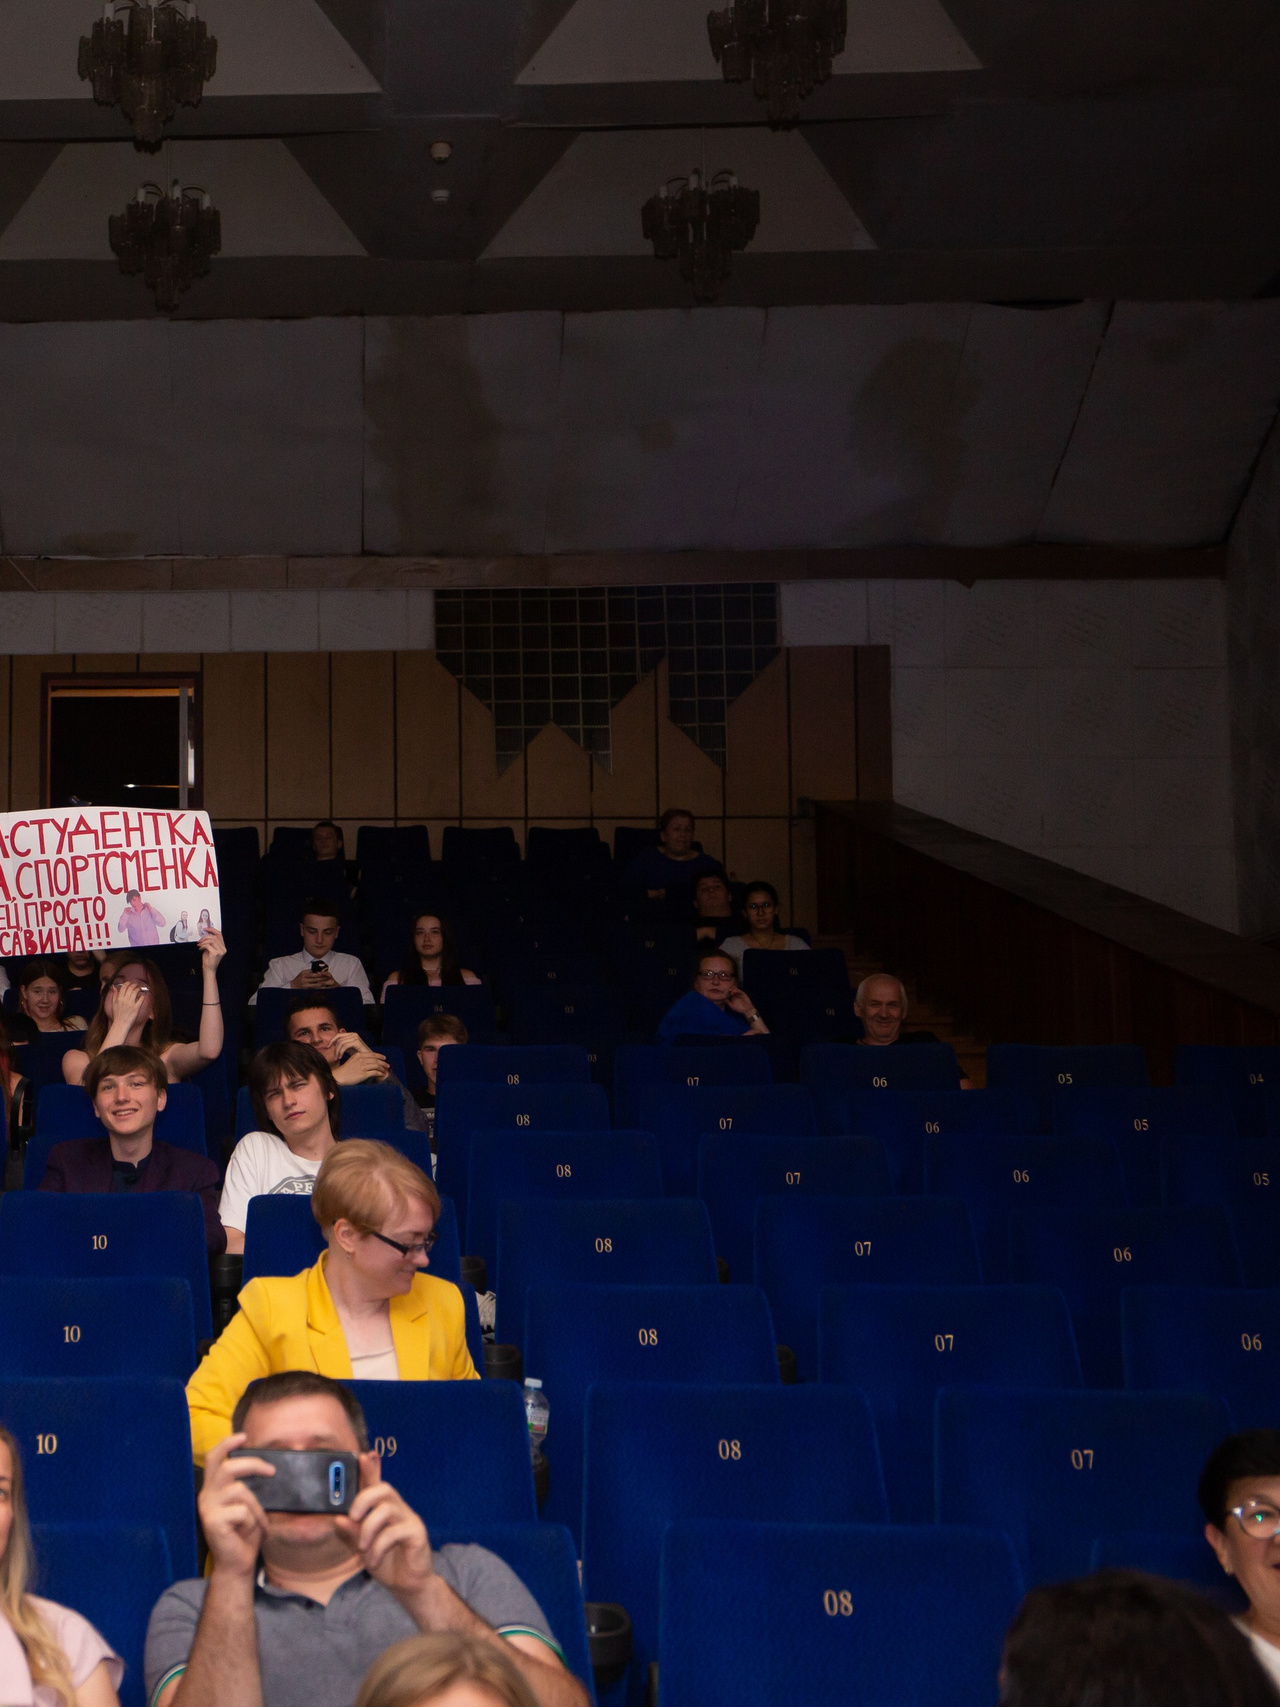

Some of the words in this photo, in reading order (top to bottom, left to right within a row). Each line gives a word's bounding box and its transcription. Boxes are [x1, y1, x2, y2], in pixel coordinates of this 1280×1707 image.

[15, 847, 219, 899] СПОРТСМЕНКА
[24, 896, 106, 929] ПРОСТО
[506, 1074, 520, 1085] 08
[686, 1076, 700, 1086] 07
[872, 1076, 888, 1088] 06
[1057, 1073, 1073, 1085] 05
[1249, 1073, 1265, 1085] 04
[515, 1114, 531, 1127] 08
[718, 1117, 733, 1130] 07
[925, 1121, 940, 1134] 06
[1133, 1118, 1149, 1131] 05
[556, 1164, 572, 1178] 08
[785, 1171, 801, 1185] 07
[1012, 1169, 1030, 1184] 06
[1253, 1172, 1270, 1186] 05
[92, 1234, 108, 1250] 10
[594, 1237, 613, 1253] 08
[854, 1240, 872, 1257] 07
[1113, 1246, 1132, 1263] 06
[63, 1325, 81, 1343] 10
[638, 1328, 659, 1346] 08
[1241, 1333, 1263, 1351] 06
[934, 1333, 954, 1352] 07
[36, 1433, 58, 1455] 10
[374, 1436, 398, 1458] 09
[718, 1439, 742, 1461] 08
[1070, 1448, 1094, 1470] 07
[823, 1589, 854, 1617] 08
